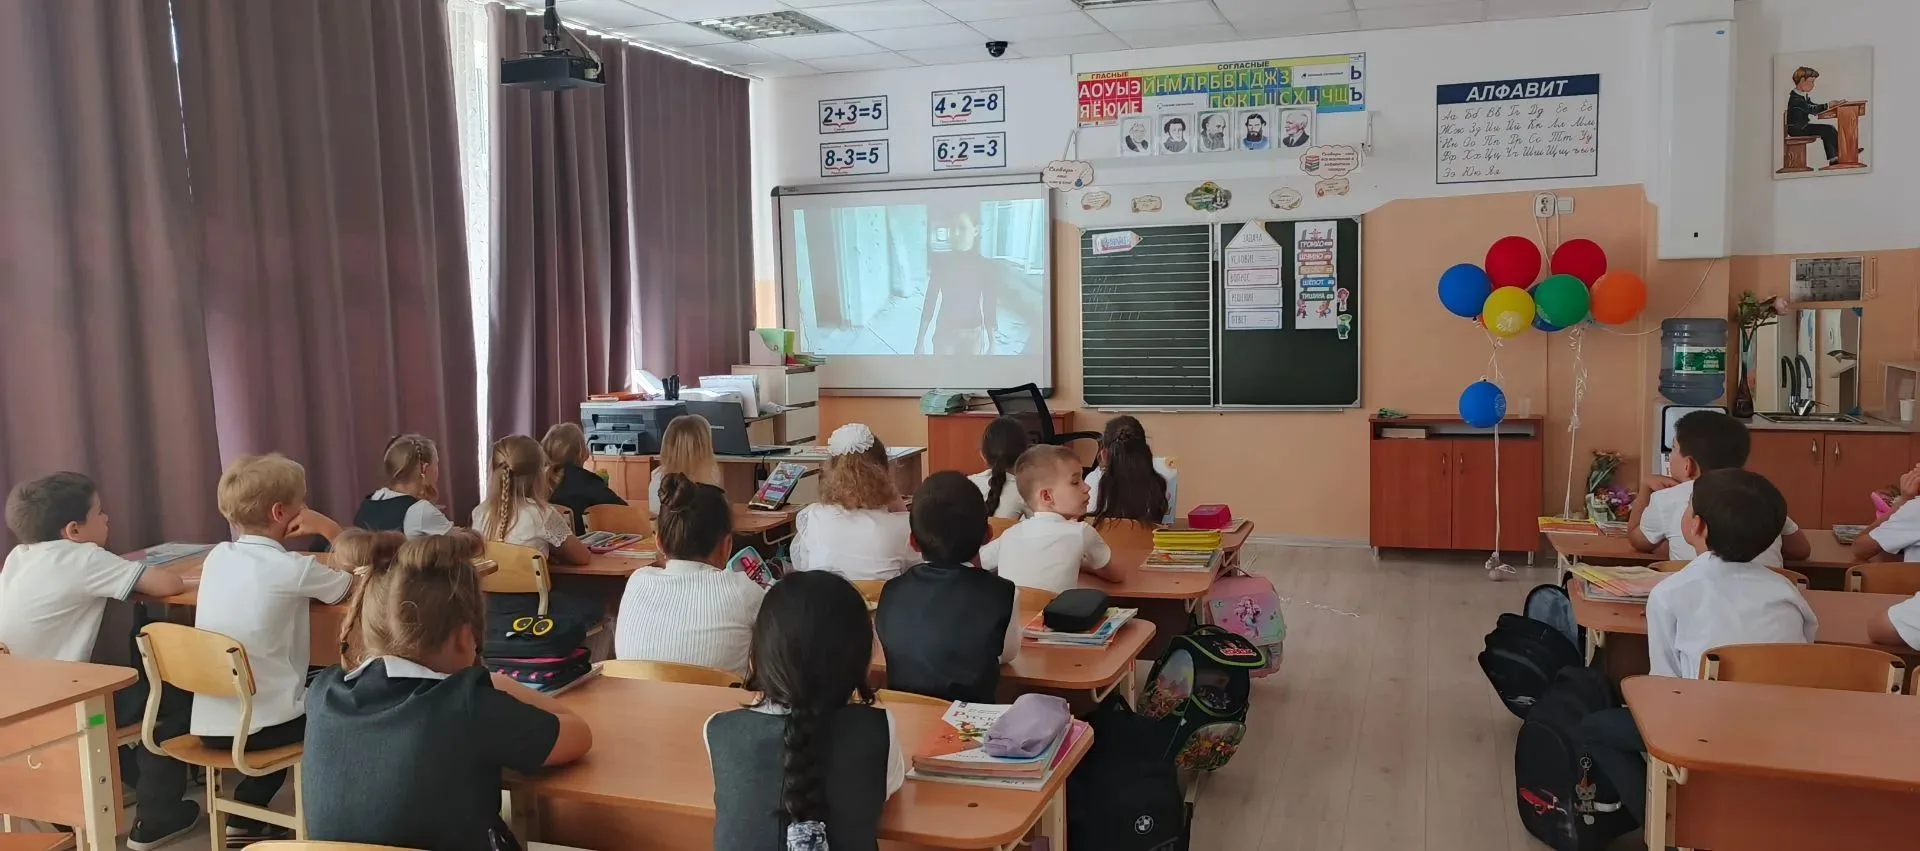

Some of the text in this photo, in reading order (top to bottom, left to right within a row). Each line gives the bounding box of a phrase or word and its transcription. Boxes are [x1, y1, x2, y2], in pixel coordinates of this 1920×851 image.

[1217, 61, 1270, 71] СОГЛАСНЫЕ
[1091, 71, 1129, 80] ГЛАСНЫЕ
[1466, 80, 1568, 101] АЛФАВИТ
[823, 103, 882, 123] 2+3=5
[1487, 107, 1502, 118] Вв
[825, 147, 879, 167] 8-3=5
[1243, 233, 1263, 243] ЗАДАЧА
[1230, 254, 1254, 264] УСЛОВИЕ
[1231, 292, 1254, 303] РЕШЕНИЕ
[1231, 314, 1247, 324] ОТВЕТ
